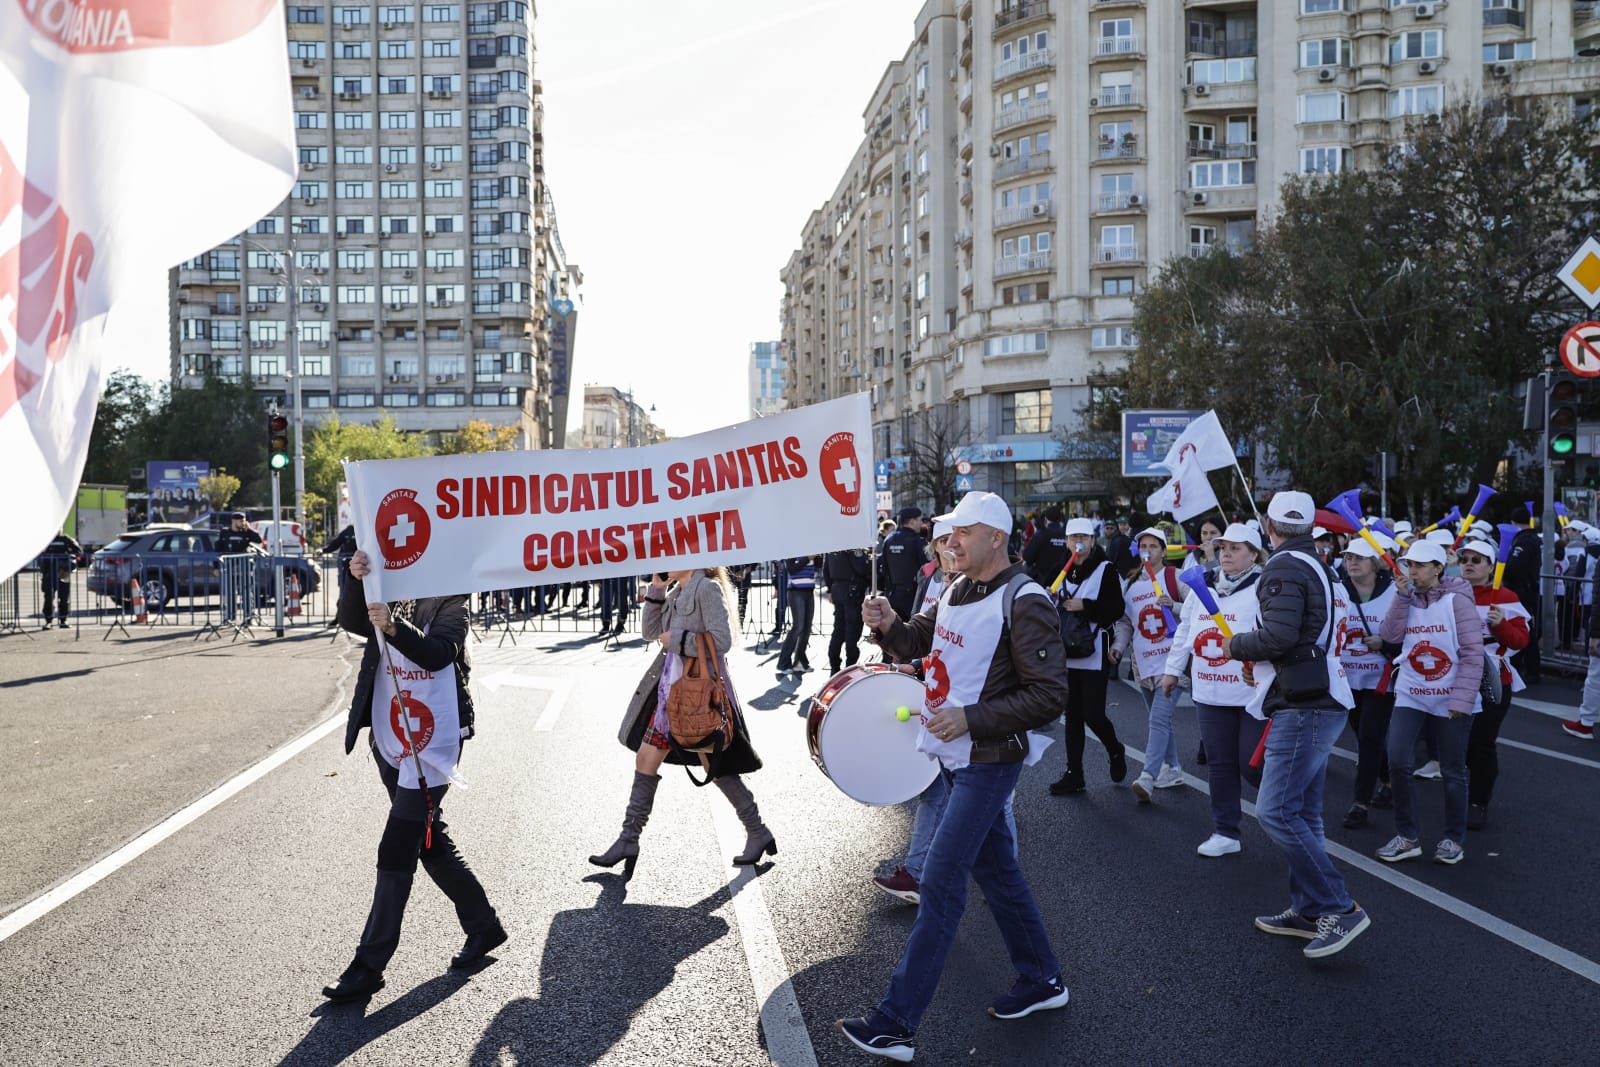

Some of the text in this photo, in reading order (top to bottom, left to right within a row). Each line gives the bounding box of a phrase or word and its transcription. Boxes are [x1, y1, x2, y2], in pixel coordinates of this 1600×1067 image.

[553, 320, 567, 396] MedLife
[824, 434, 853, 451] SANITAS
[436, 436, 808, 520] SINDICATUL SANITAS
[382, 490, 415, 507] SANITAS
[385, 551, 422, 569] ROMANIA
[523, 510, 746, 571] CONSTANTA
